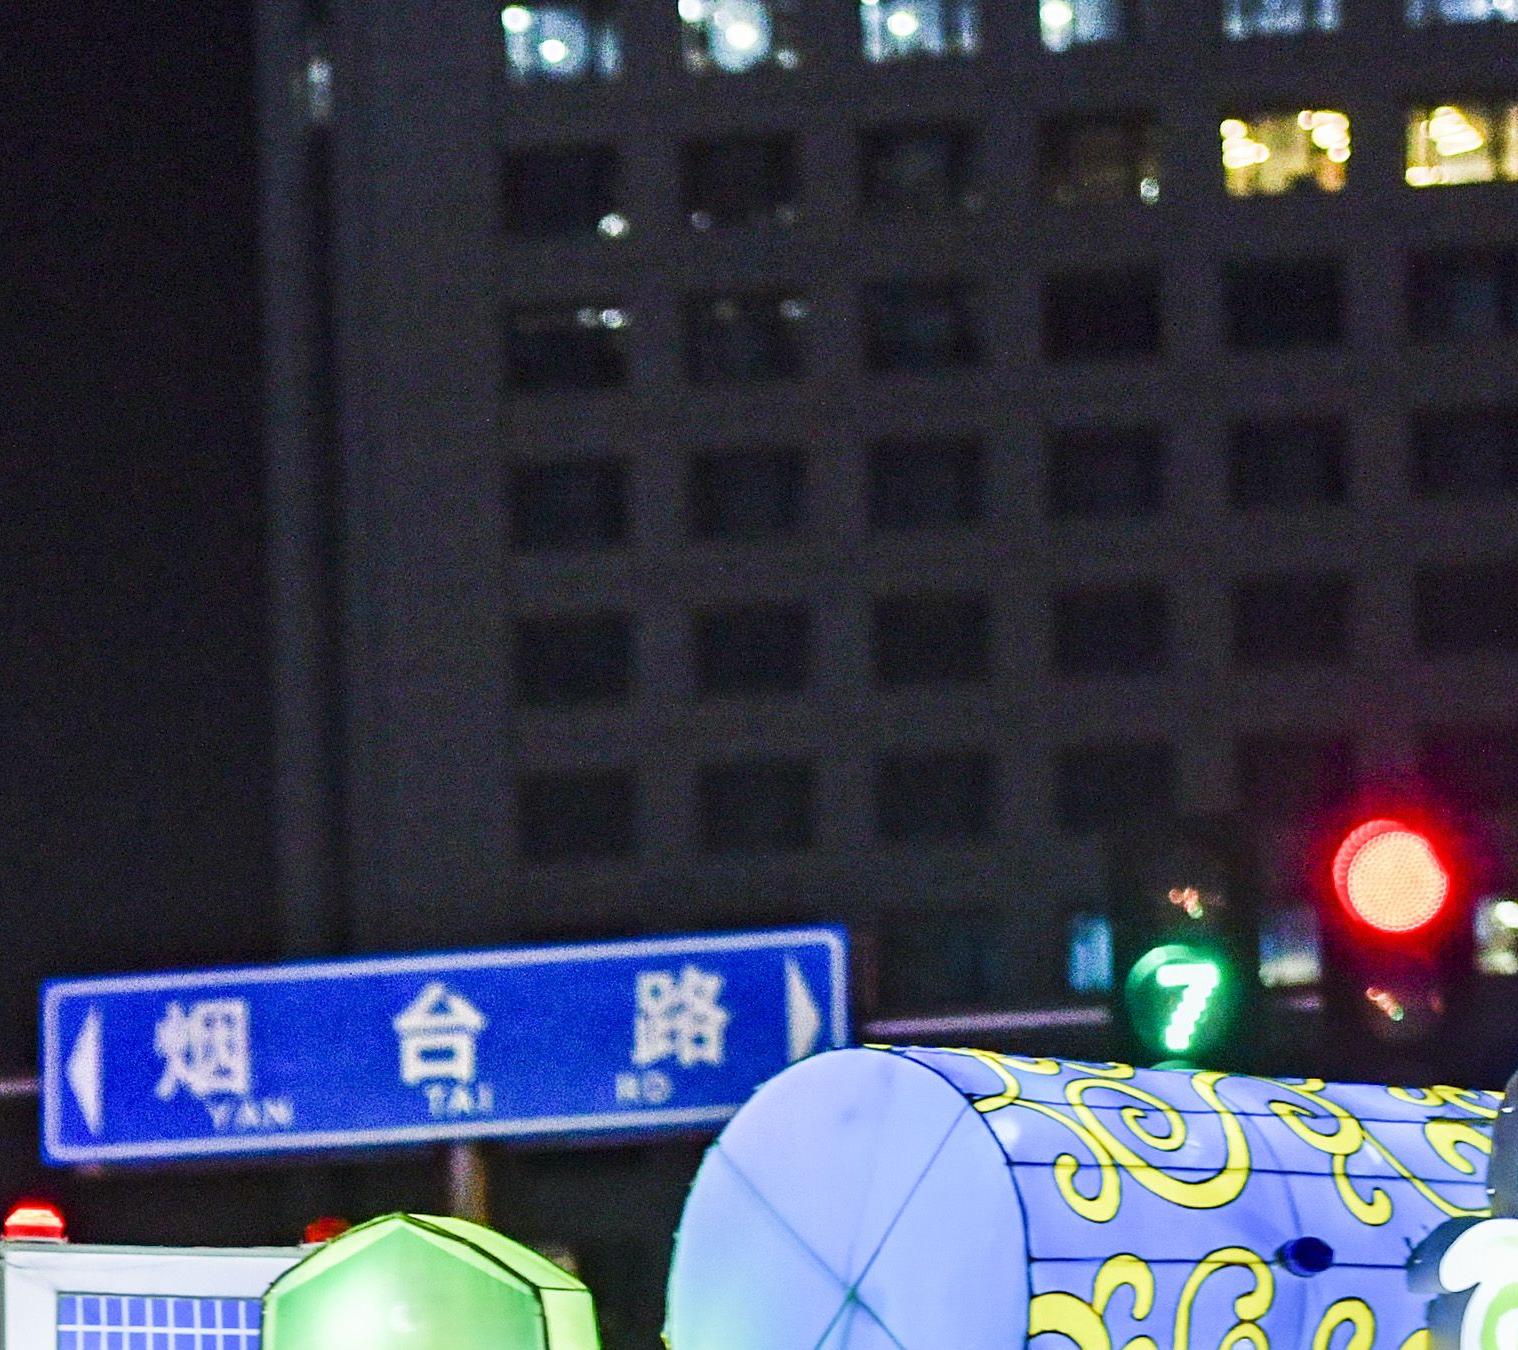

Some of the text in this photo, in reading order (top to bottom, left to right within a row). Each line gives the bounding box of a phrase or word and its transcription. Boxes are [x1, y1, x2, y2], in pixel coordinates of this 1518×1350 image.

[154, 967, 729, 1100] 烟台路
[1155, 962, 1220, 1053] 7
[208, 1096, 295, 1131] YAN
[424, 1084, 494, 1118] TAI
